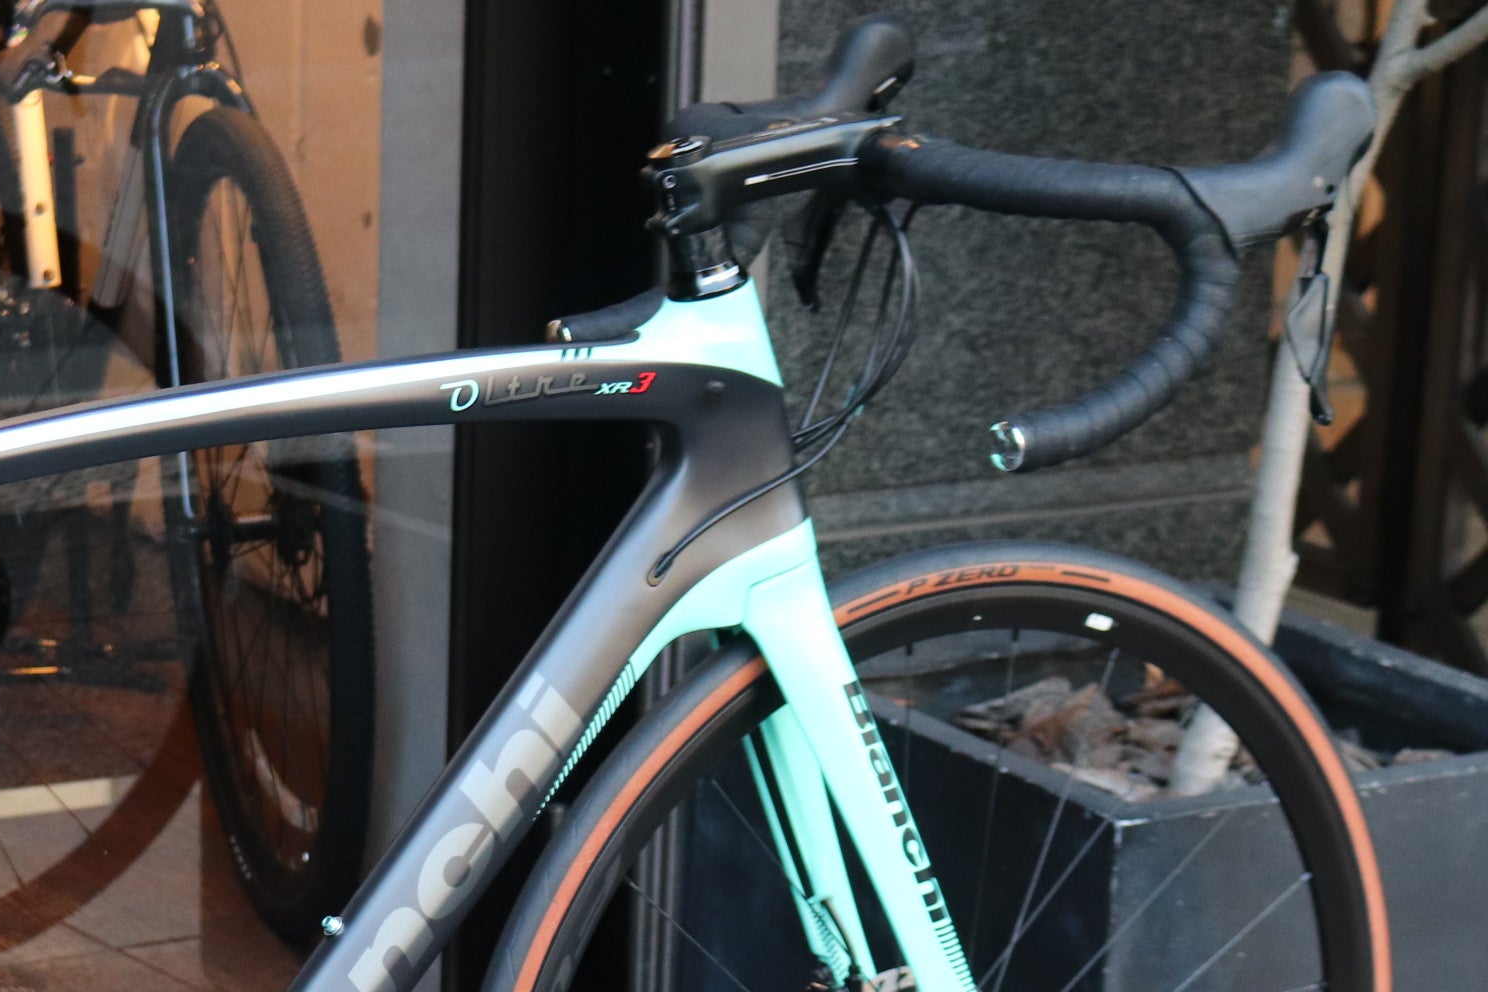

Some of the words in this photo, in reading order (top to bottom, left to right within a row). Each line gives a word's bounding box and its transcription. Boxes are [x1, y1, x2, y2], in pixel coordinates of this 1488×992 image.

[439, 373, 600, 413] Oltre
[593, 371, 657, 397] XR3
[906, 577, 929, 595] P
[934, 563, 1021, 588] ZERO
[843, 681, 953, 923] Bianchi
